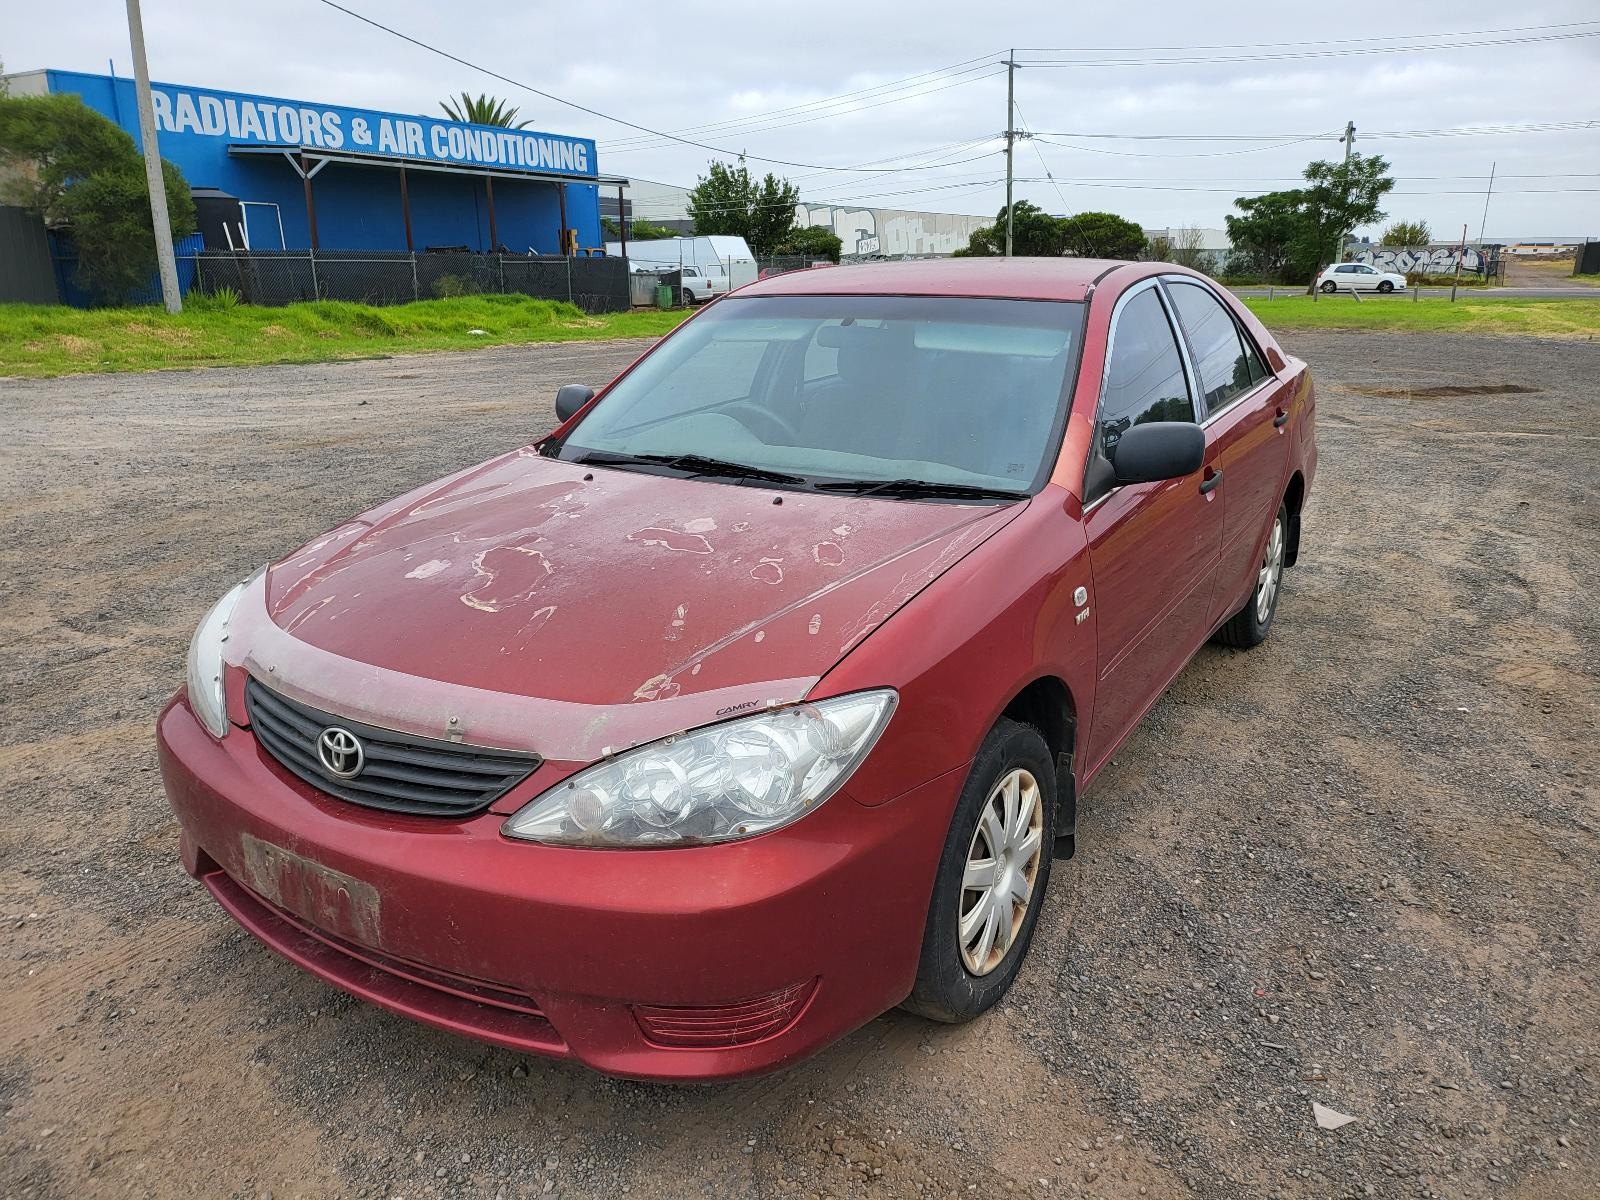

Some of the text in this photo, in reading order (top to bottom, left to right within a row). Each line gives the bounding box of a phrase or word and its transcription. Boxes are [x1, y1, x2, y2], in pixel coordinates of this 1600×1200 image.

[150, 89, 588, 172] RADIATORS & AIR CONDITIONING
[716, 699, 760, 716] CAMRY
